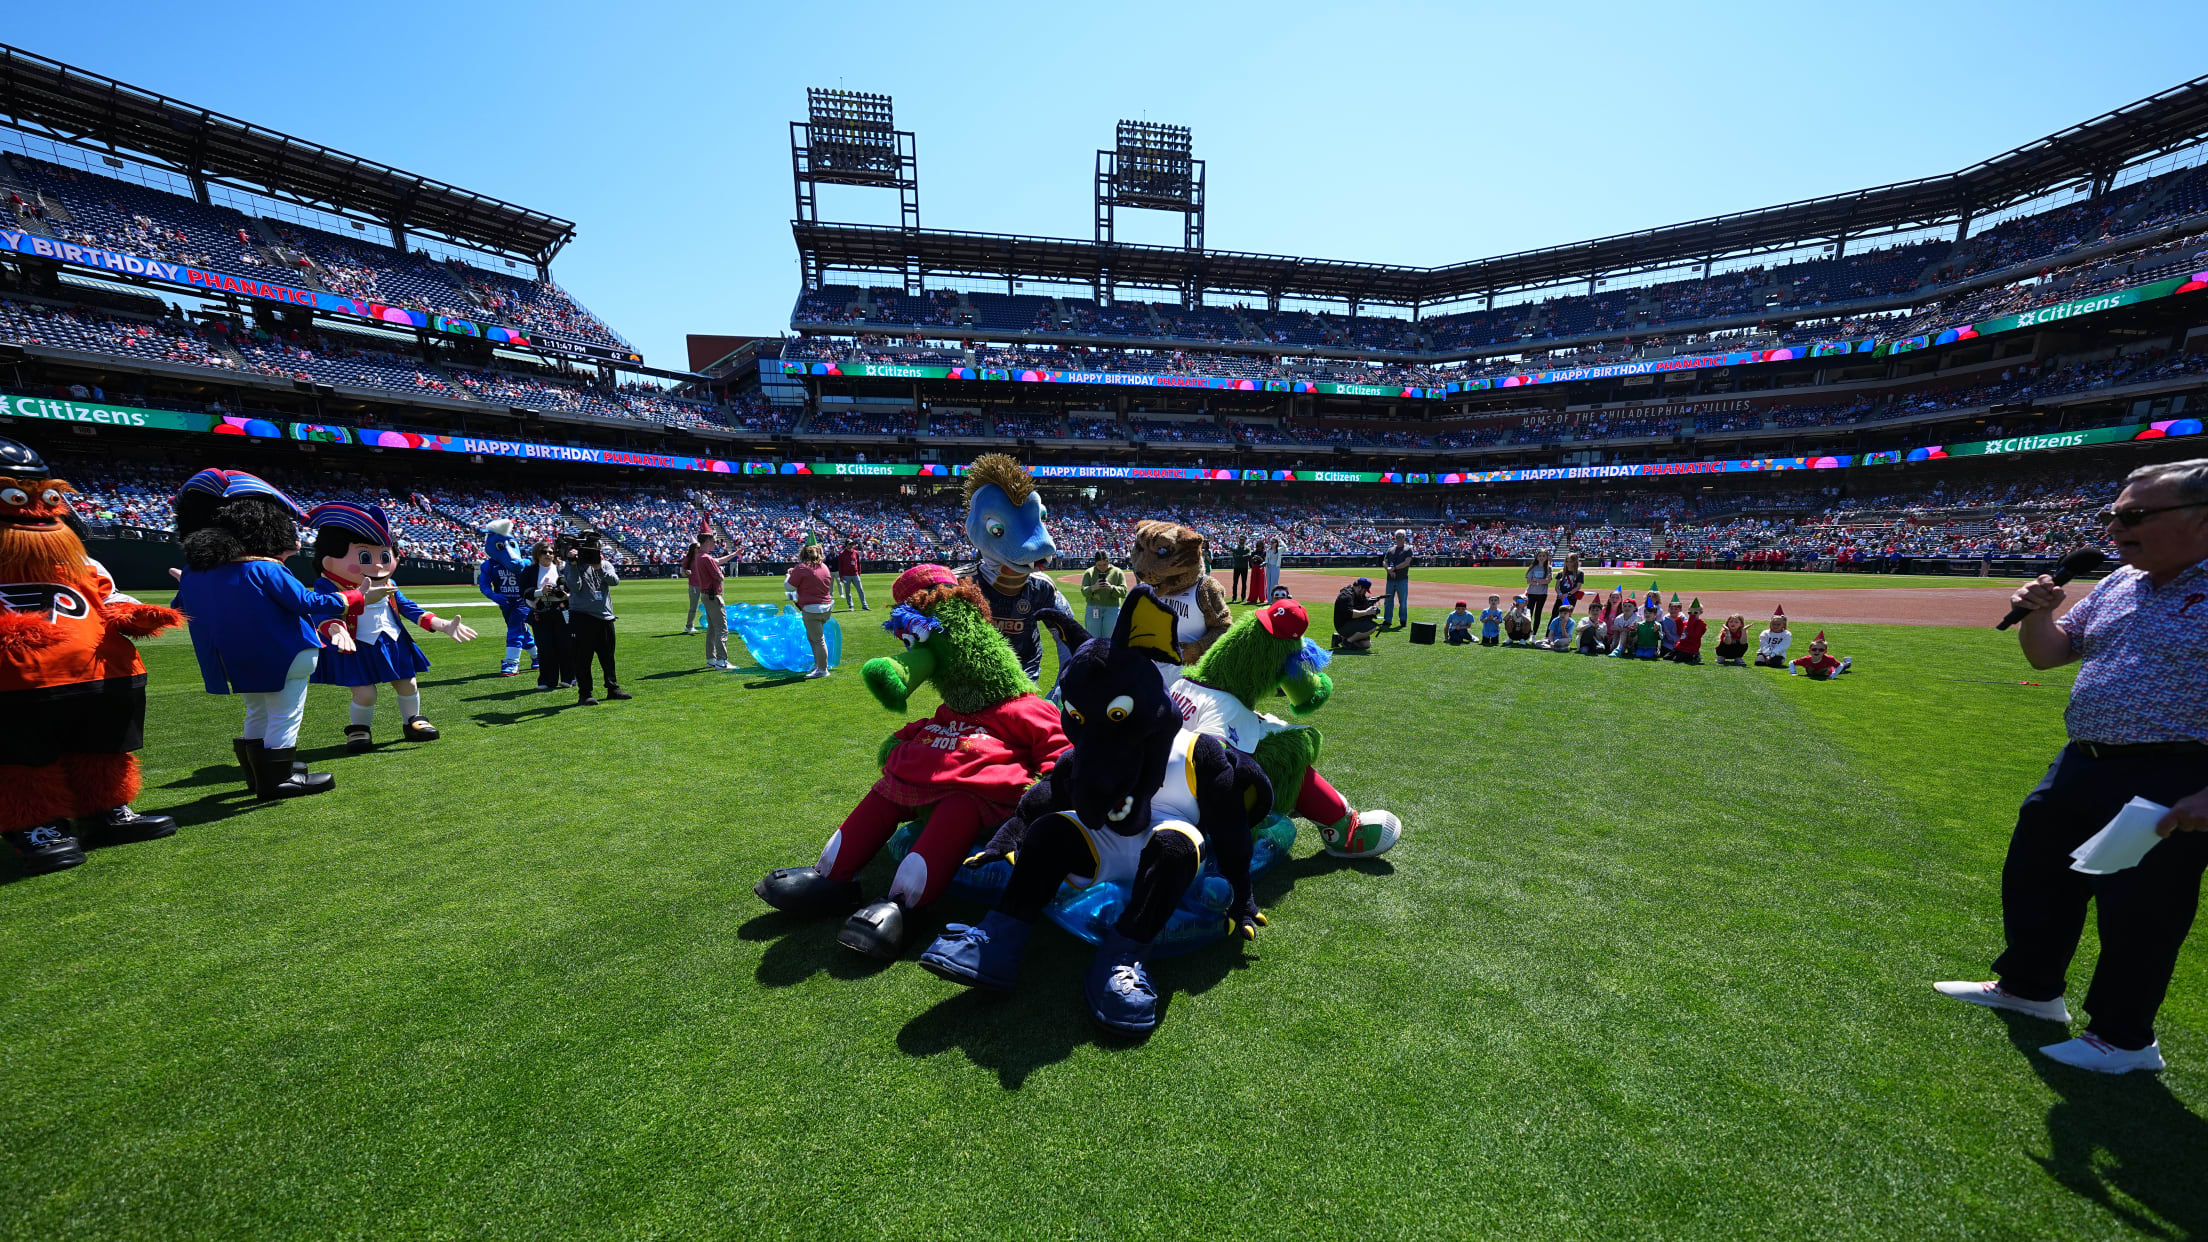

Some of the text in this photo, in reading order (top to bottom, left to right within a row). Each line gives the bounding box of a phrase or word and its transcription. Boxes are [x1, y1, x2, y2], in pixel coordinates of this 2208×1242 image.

[31, 237, 179, 280] BIRTHDAY
[186, 268, 318, 307] PHANATIC!
[2037, 295, 2120, 323] Citizens
[542, 339, 586, 353] 1:11:47 PM
[877, 365, 922, 378] Citizens
[1552, 368, 1591, 382] HAPPY
[1593, 363, 1654, 378] BIRTHDAY
[1655, 356, 1727, 372] PHANATIC!
[1068, 371, 1210, 388] HAPPY BIRTHDAY PHANATIC!
[1346, 384, 1381, 396] Citizens
[16, 398, 146, 427] Citizens
[1576, 411, 1595, 422] THE
[1603, 404, 1686, 419] PHILADELPHIA
[2004, 434, 2083, 451] Citizens
[464, 439, 675, 468] HAPPY BIRTHDAY PHANATIC!
[848, 463, 892, 475] Citizens
[1042, 466, 1186, 479] HAPPY BIRTHDAY PHANATIC!
[1325, 471, 1359, 482] Citizens
[1521, 461, 1727, 481] HAPPY BIRTHDAY PHANATIC!
[499, 576, 517, 586] 76
[1165, 598, 1189, 618] NOVA
[1171, 691, 1197, 721] NATIC
